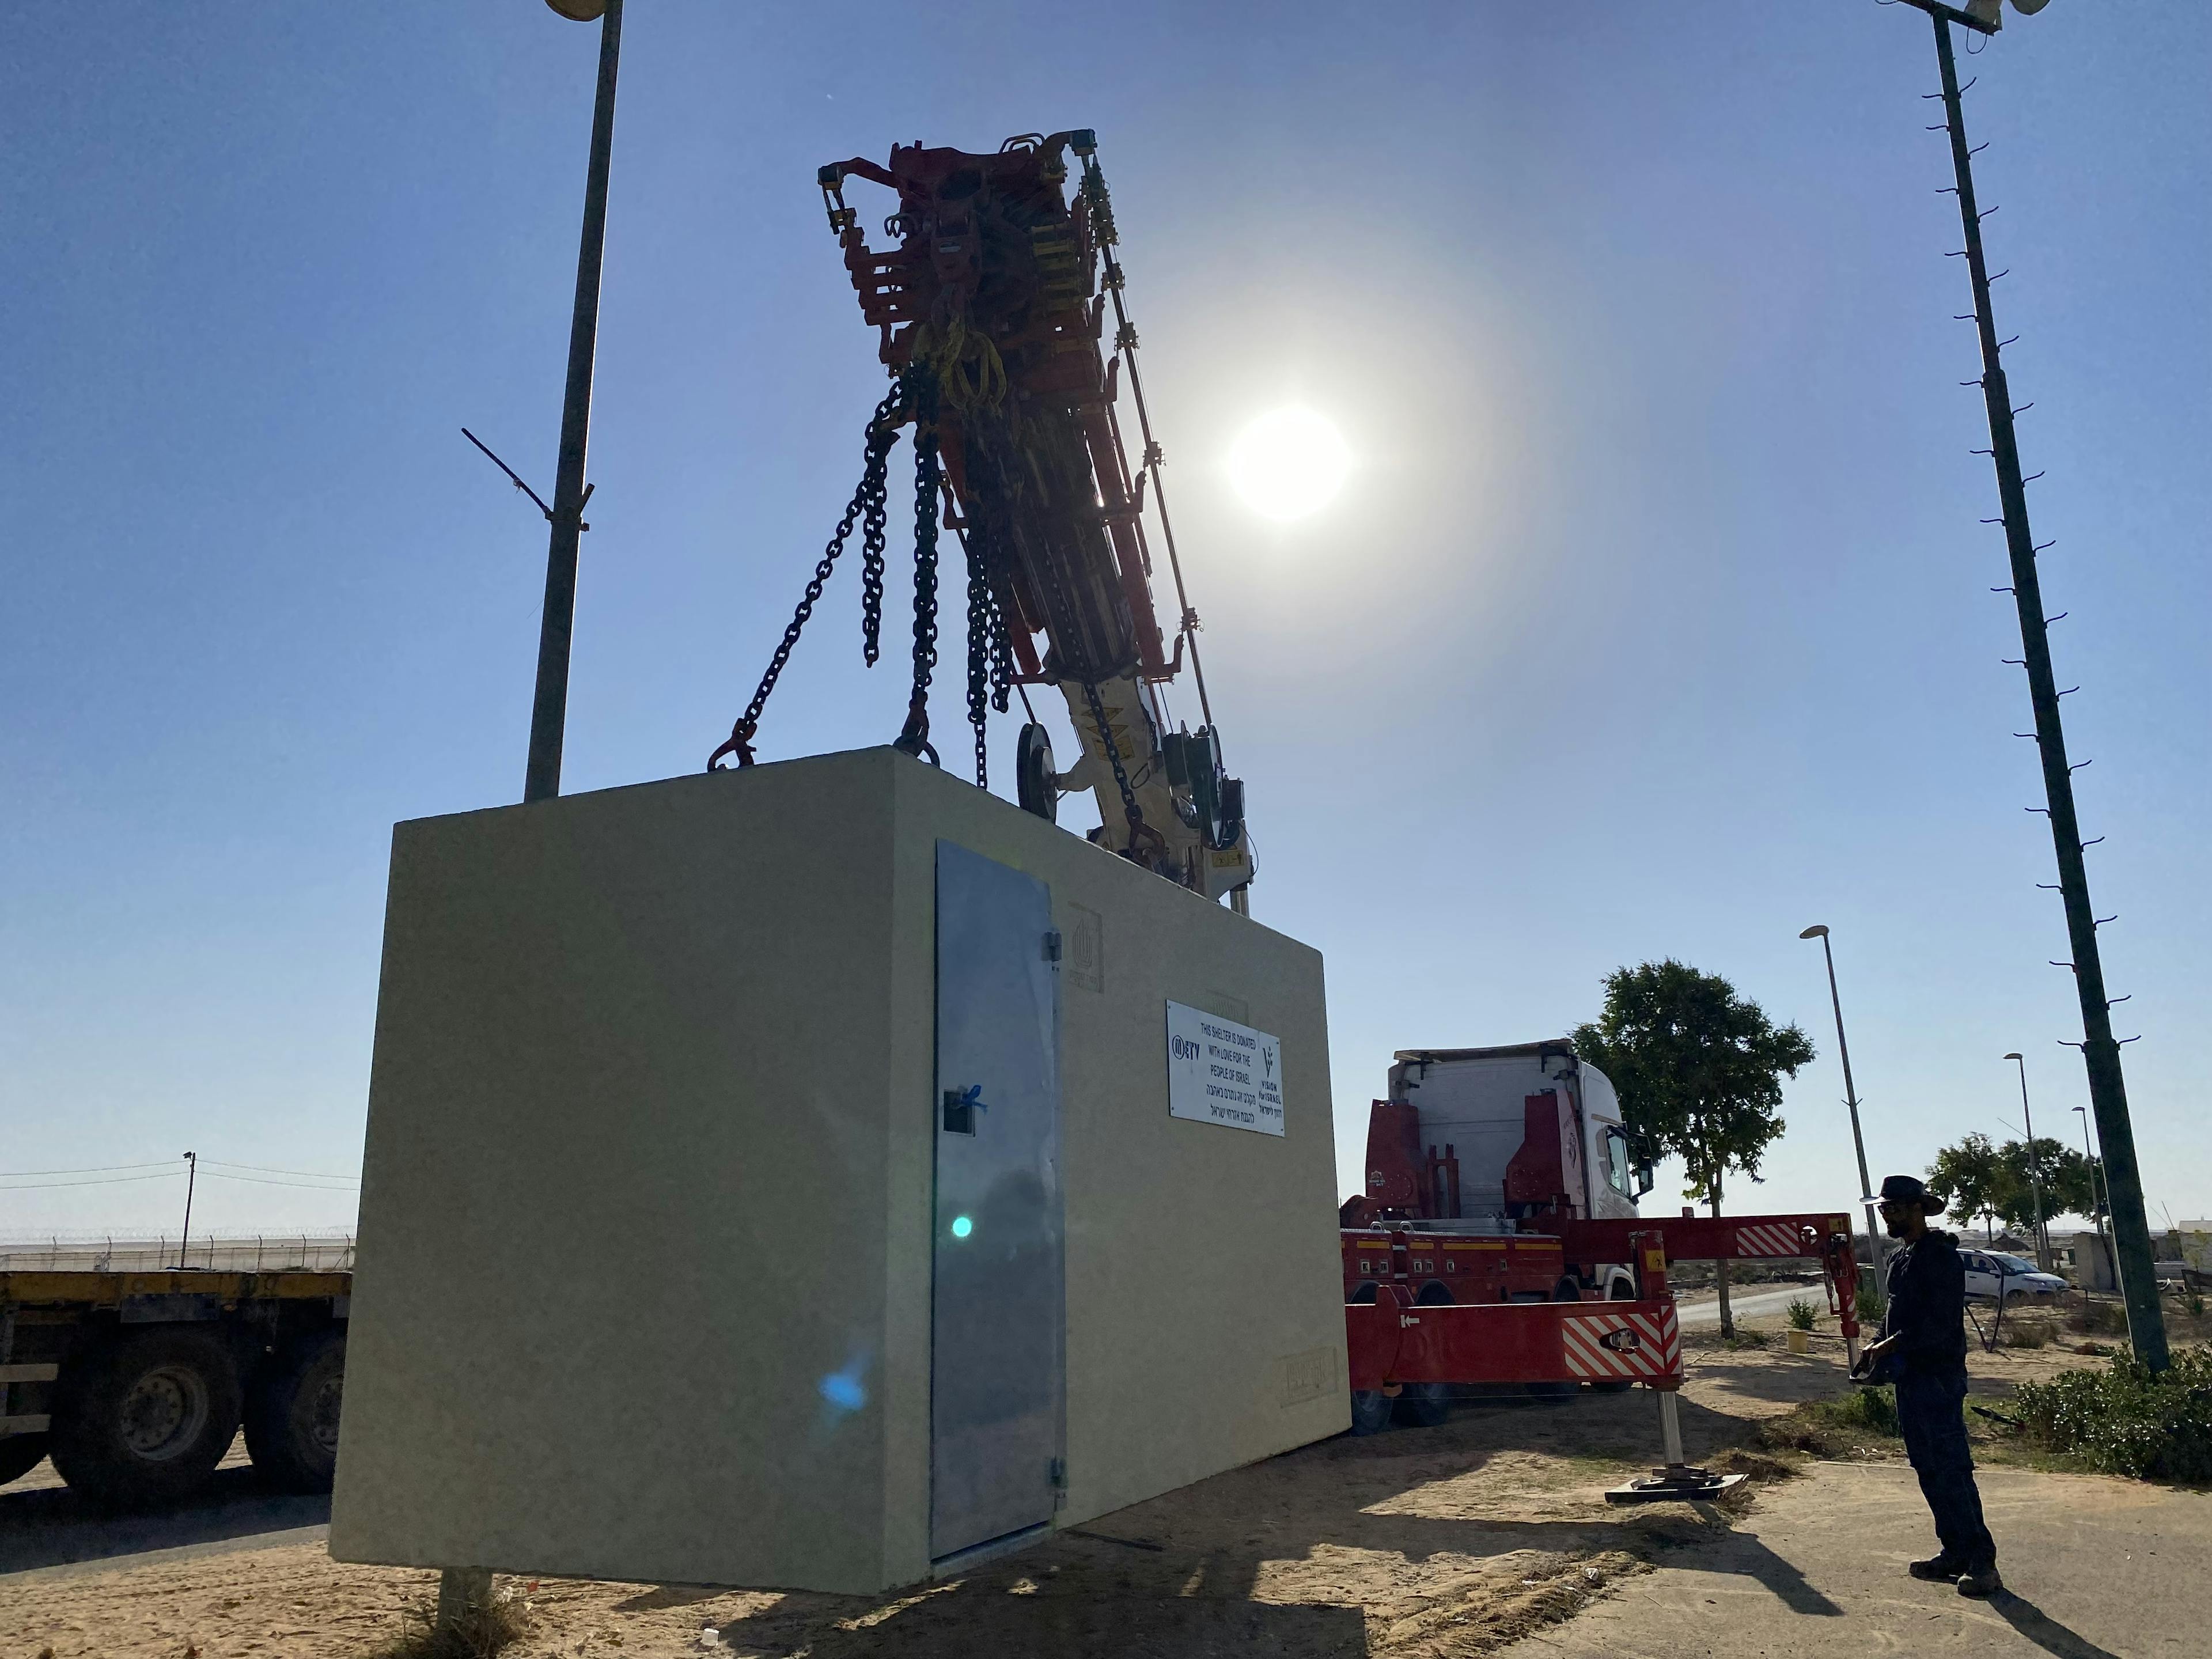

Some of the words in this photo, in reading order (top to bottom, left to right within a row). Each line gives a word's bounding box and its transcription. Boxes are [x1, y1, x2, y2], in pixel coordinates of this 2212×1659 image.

[1201, 1023, 1211, 1036] THIS
[1212, 1026, 1232, 1043] SHELTER
[1232, 1033, 1236, 1044] IS
[1237, 1034, 1256, 1050] DONATED
[1209, 1044, 1220, 1058] WITH
[1221, 1048, 1232, 1062] LOVE
[1233, 1052, 1242, 1064] FOR
[1243, 1054, 1251, 1067] THE
[1211, 1065, 1228, 1080] PEOPLE
[1229, 1069, 1234, 1081] OF
[1236, 1071, 1251, 1085] ISRAEL
[1207, 1084, 1224, 1098] באהבה
[1262, 1080, 1277, 1092] VISION
[1237, 1091, 1243, 1102] זה
[1265, 1092, 1281, 1105] ISRAEL
[1210, 1103, 1226, 1119] ישראל
[1259, 1103, 1273, 1115] לישראל
